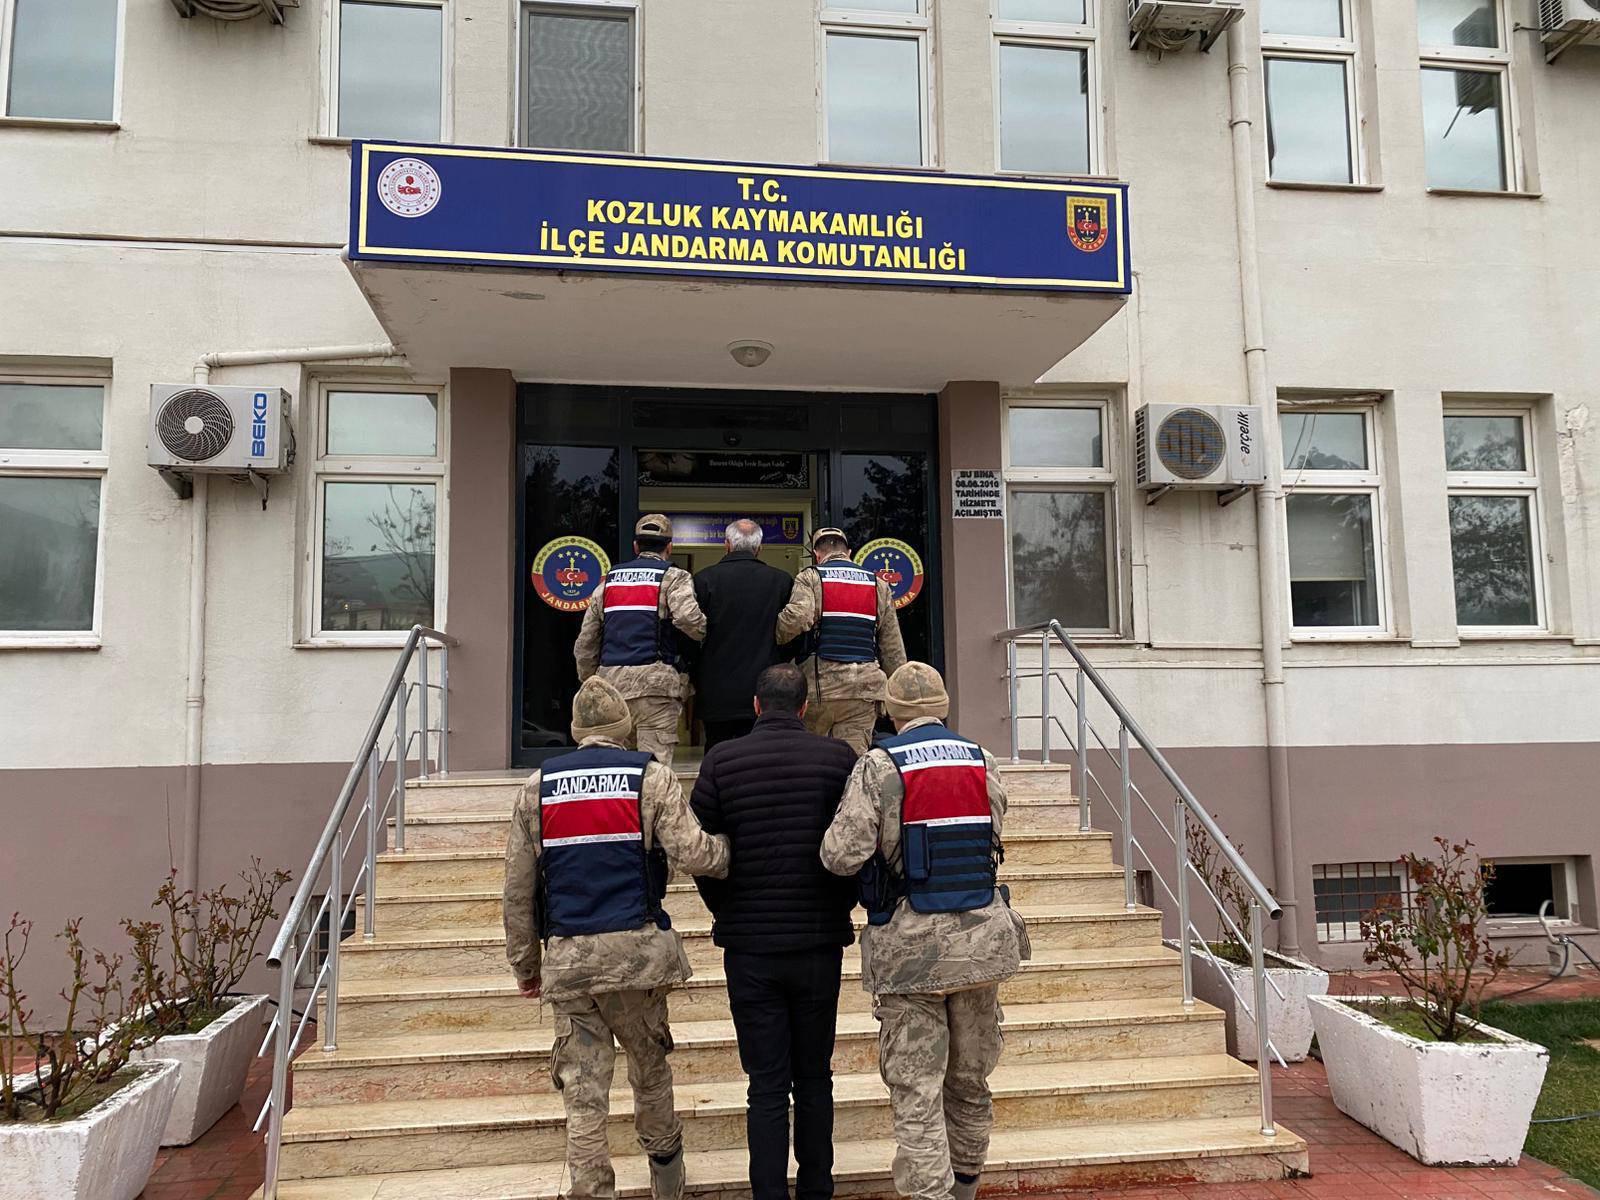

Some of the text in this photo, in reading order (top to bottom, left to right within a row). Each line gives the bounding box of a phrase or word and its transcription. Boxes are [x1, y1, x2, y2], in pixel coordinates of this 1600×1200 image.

[738, 178, 788, 203] T.C.
[588, 200, 923, 238] KOZLUK KAYMAKAMLIĞI
[540, 221, 966, 271] İLÇE JANDARMA KOMUTANLIĞI
[252, 393, 267, 457] BEKO
[1237, 411, 1252, 454] arçelik
[960, 470, 971, 478] BU
[955, 489, 1000, 498] TARİHİNDE
[960, 498, 997, 507] HİZMETE
[955, 509, 1003, 518] AÇILMIŞTIR
[610, 571, 656, 582] JANDARMA
[825, 569, 870, 582] JANDARMA
[541, 592, 593, 610] JANDARM
[905, 745, 974, 764] JANDARMA
[551, 775, 630, 796] JANDARMA
